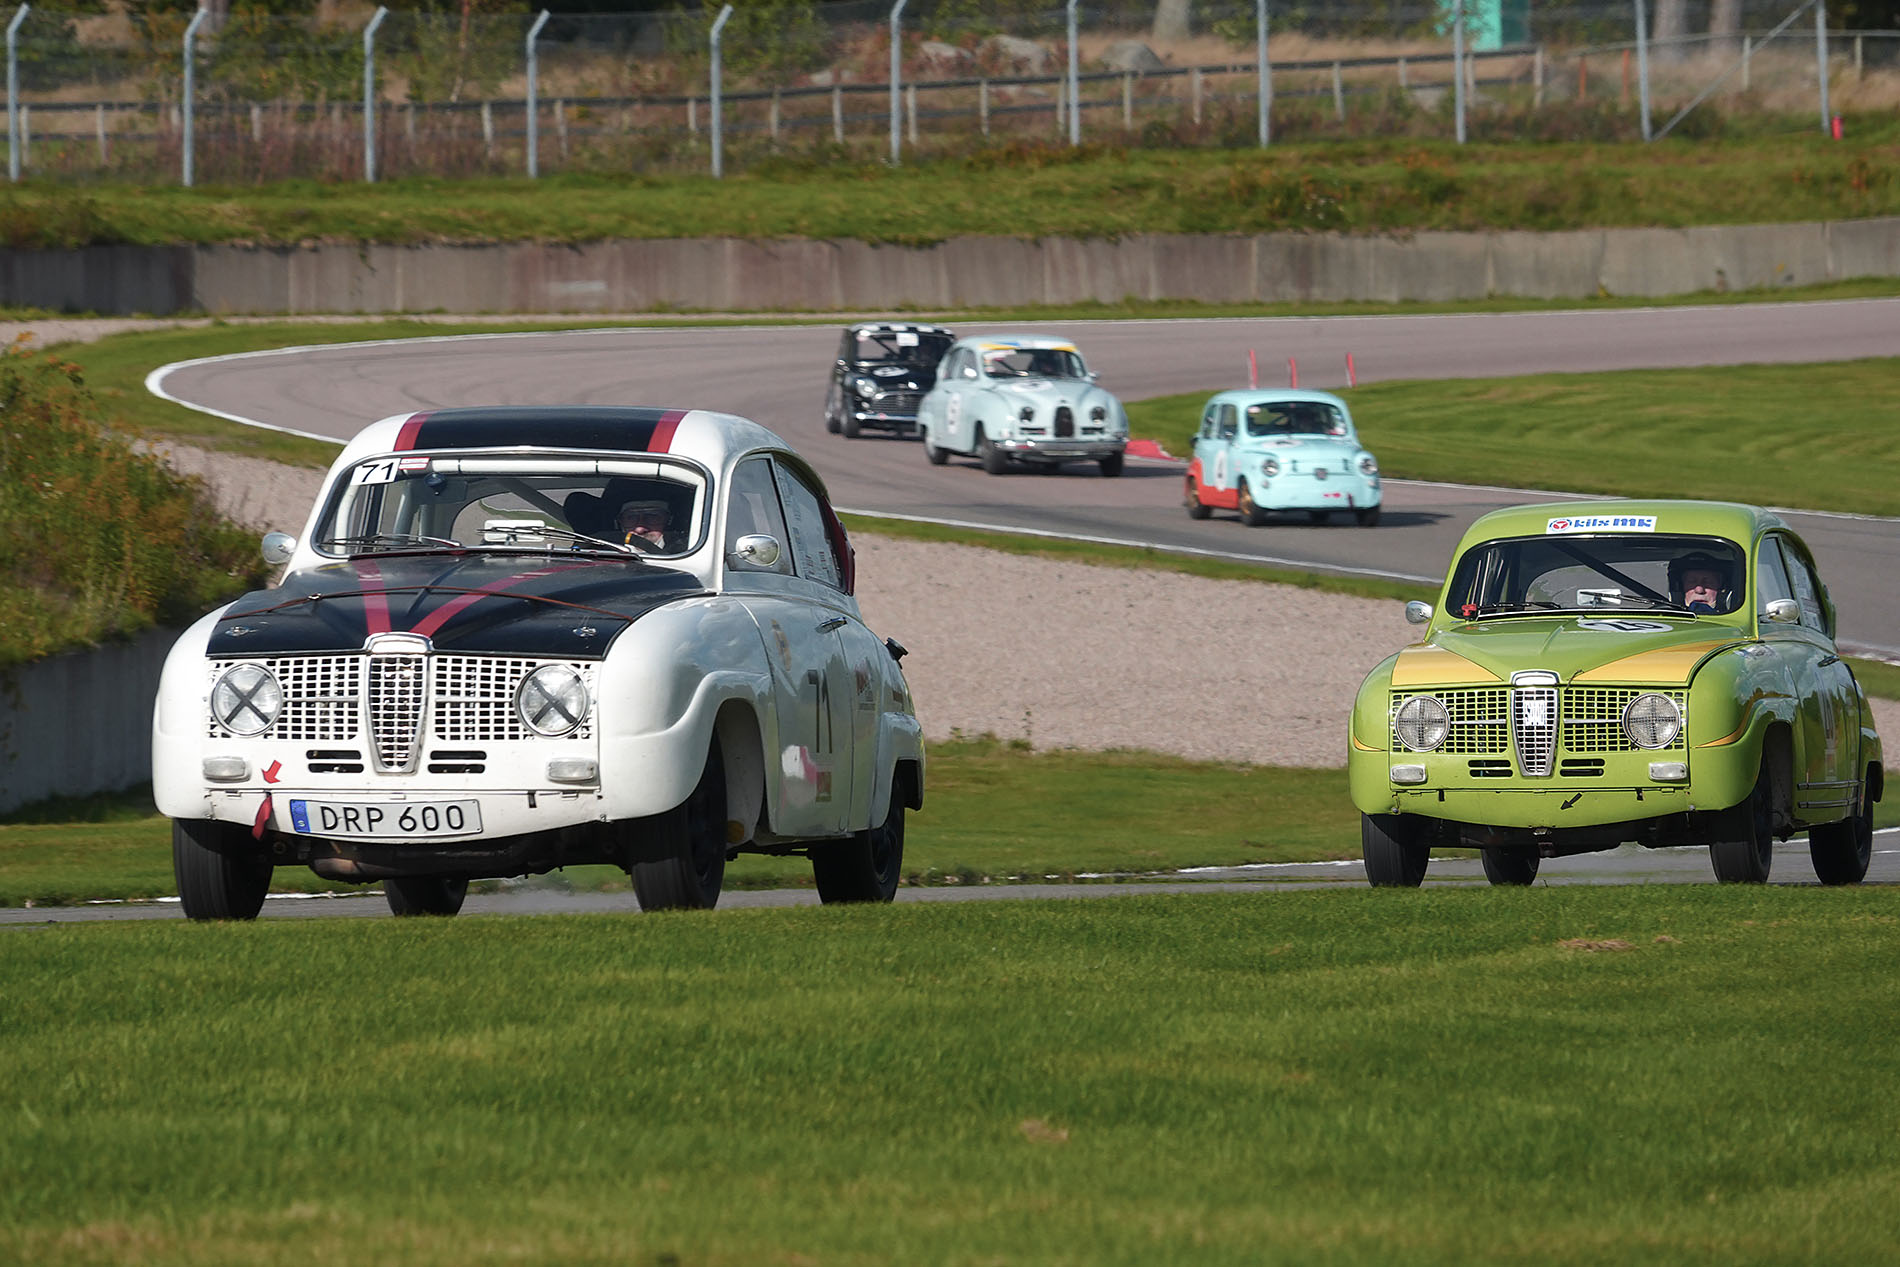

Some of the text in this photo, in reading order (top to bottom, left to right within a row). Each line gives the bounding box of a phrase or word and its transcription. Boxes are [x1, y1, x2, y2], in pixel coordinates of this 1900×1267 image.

[362, 462, 394, 482] 71
[807, 669, 833, 754] 71
[320, 804, 464, 832] DRP 600
